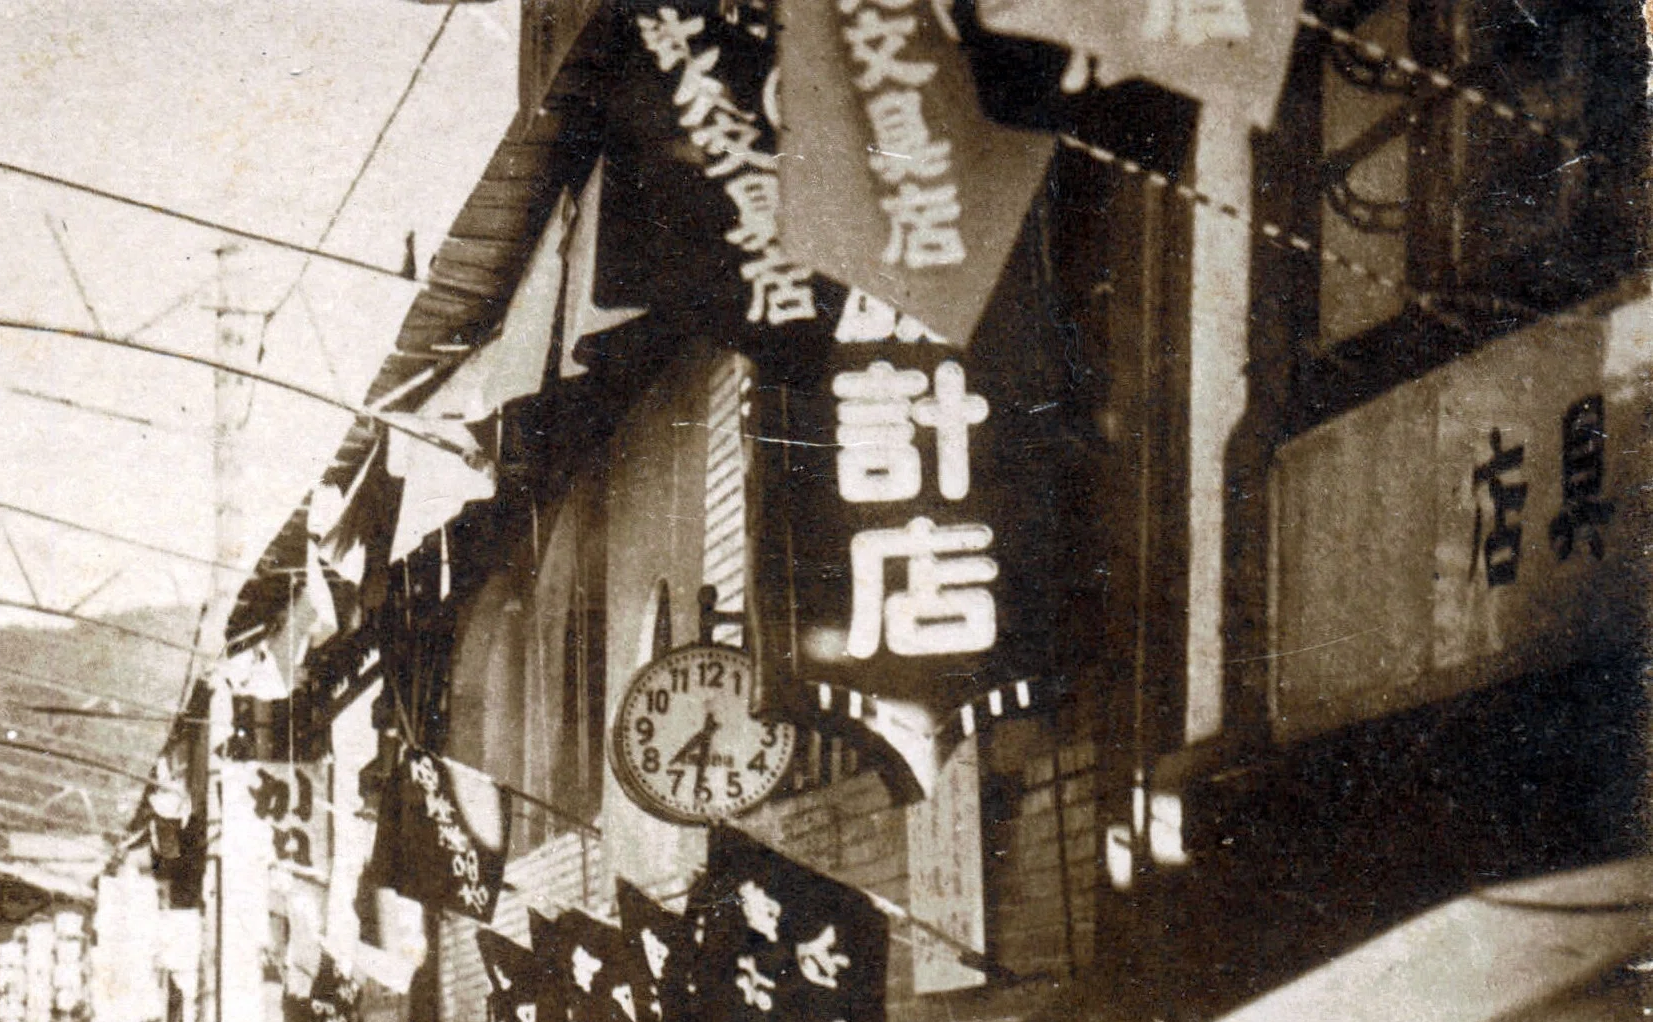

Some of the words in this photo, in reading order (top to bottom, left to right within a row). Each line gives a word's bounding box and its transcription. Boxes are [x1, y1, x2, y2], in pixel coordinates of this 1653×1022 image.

[845, 0, 969, 268] 文具店
[671, 668, 688, 693] 11
[699, 661, 724, 688] 12
[733, 671, 742, 695] 1
[647, 689, 669, 715] 10
[636, 716, 654, 746] 9
[761, 722, 777, 747] 3
[642, 747, 660, 773] 8
[748, 751, 768, 775] 4
[666, 769, 685, 796] 7
[727, 771, 743, 797] 5
